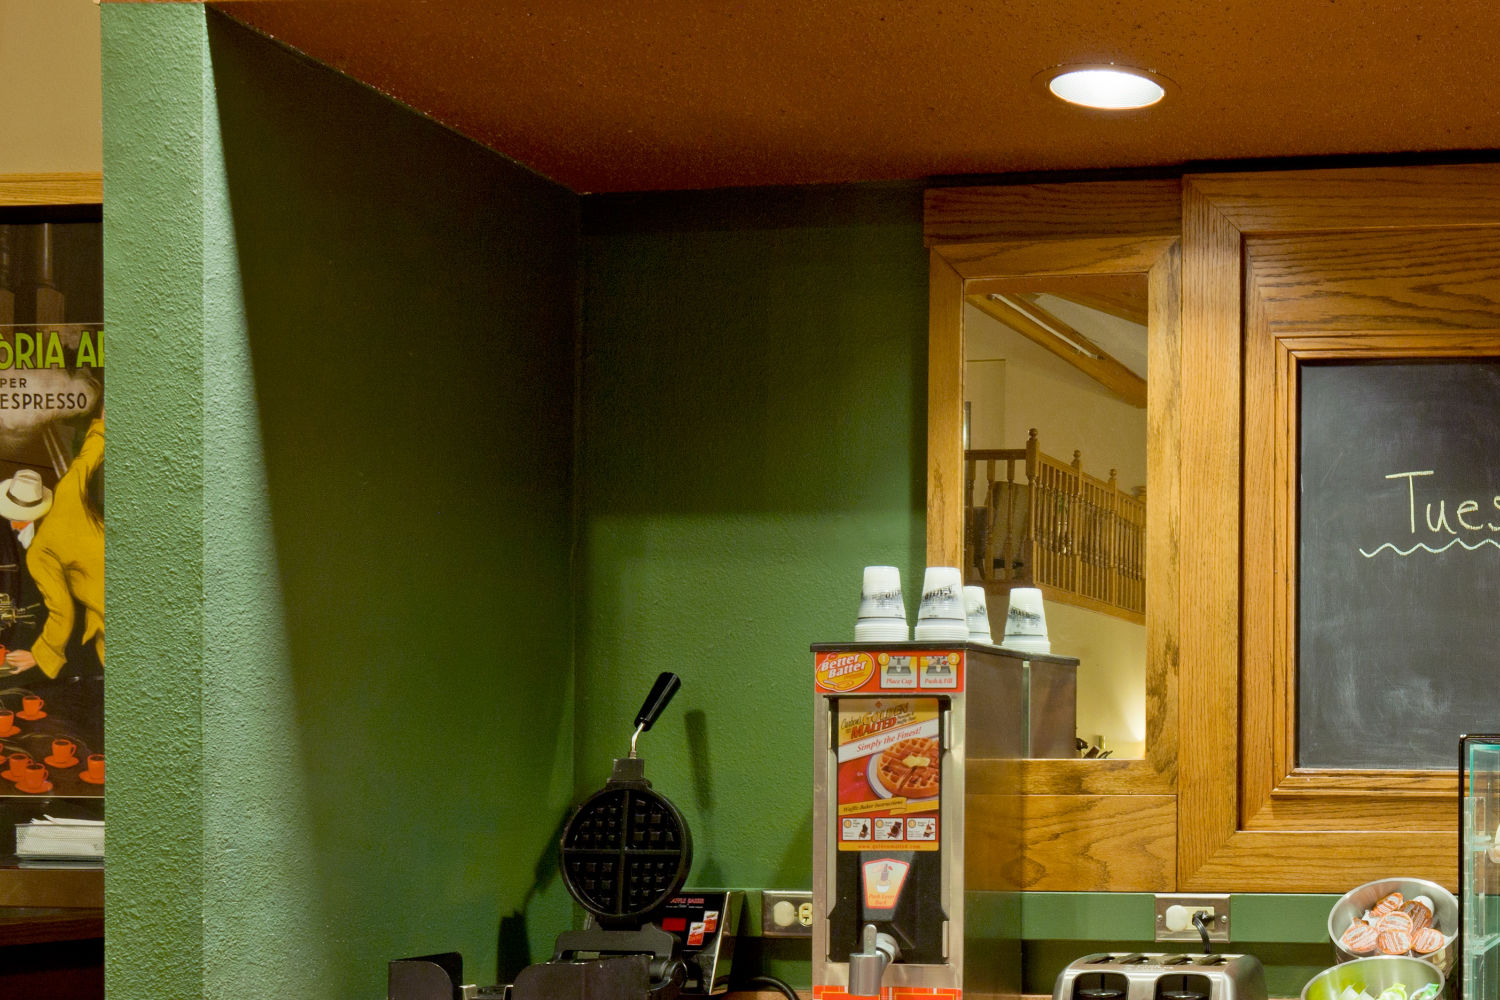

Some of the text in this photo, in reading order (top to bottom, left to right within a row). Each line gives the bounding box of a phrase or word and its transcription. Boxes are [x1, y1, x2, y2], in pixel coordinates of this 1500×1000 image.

[0, 377, 27, 389] PER
[0, 392, 87, 410] ESPRESSO
[820, 654, 860, 672] Better
[828, 661, 867, 679] Batter
[901, 678, 913, 686] Cup
[851, 717, 897, 739] MALTED
[857, 726, 922, 752] Simply the Finest!
